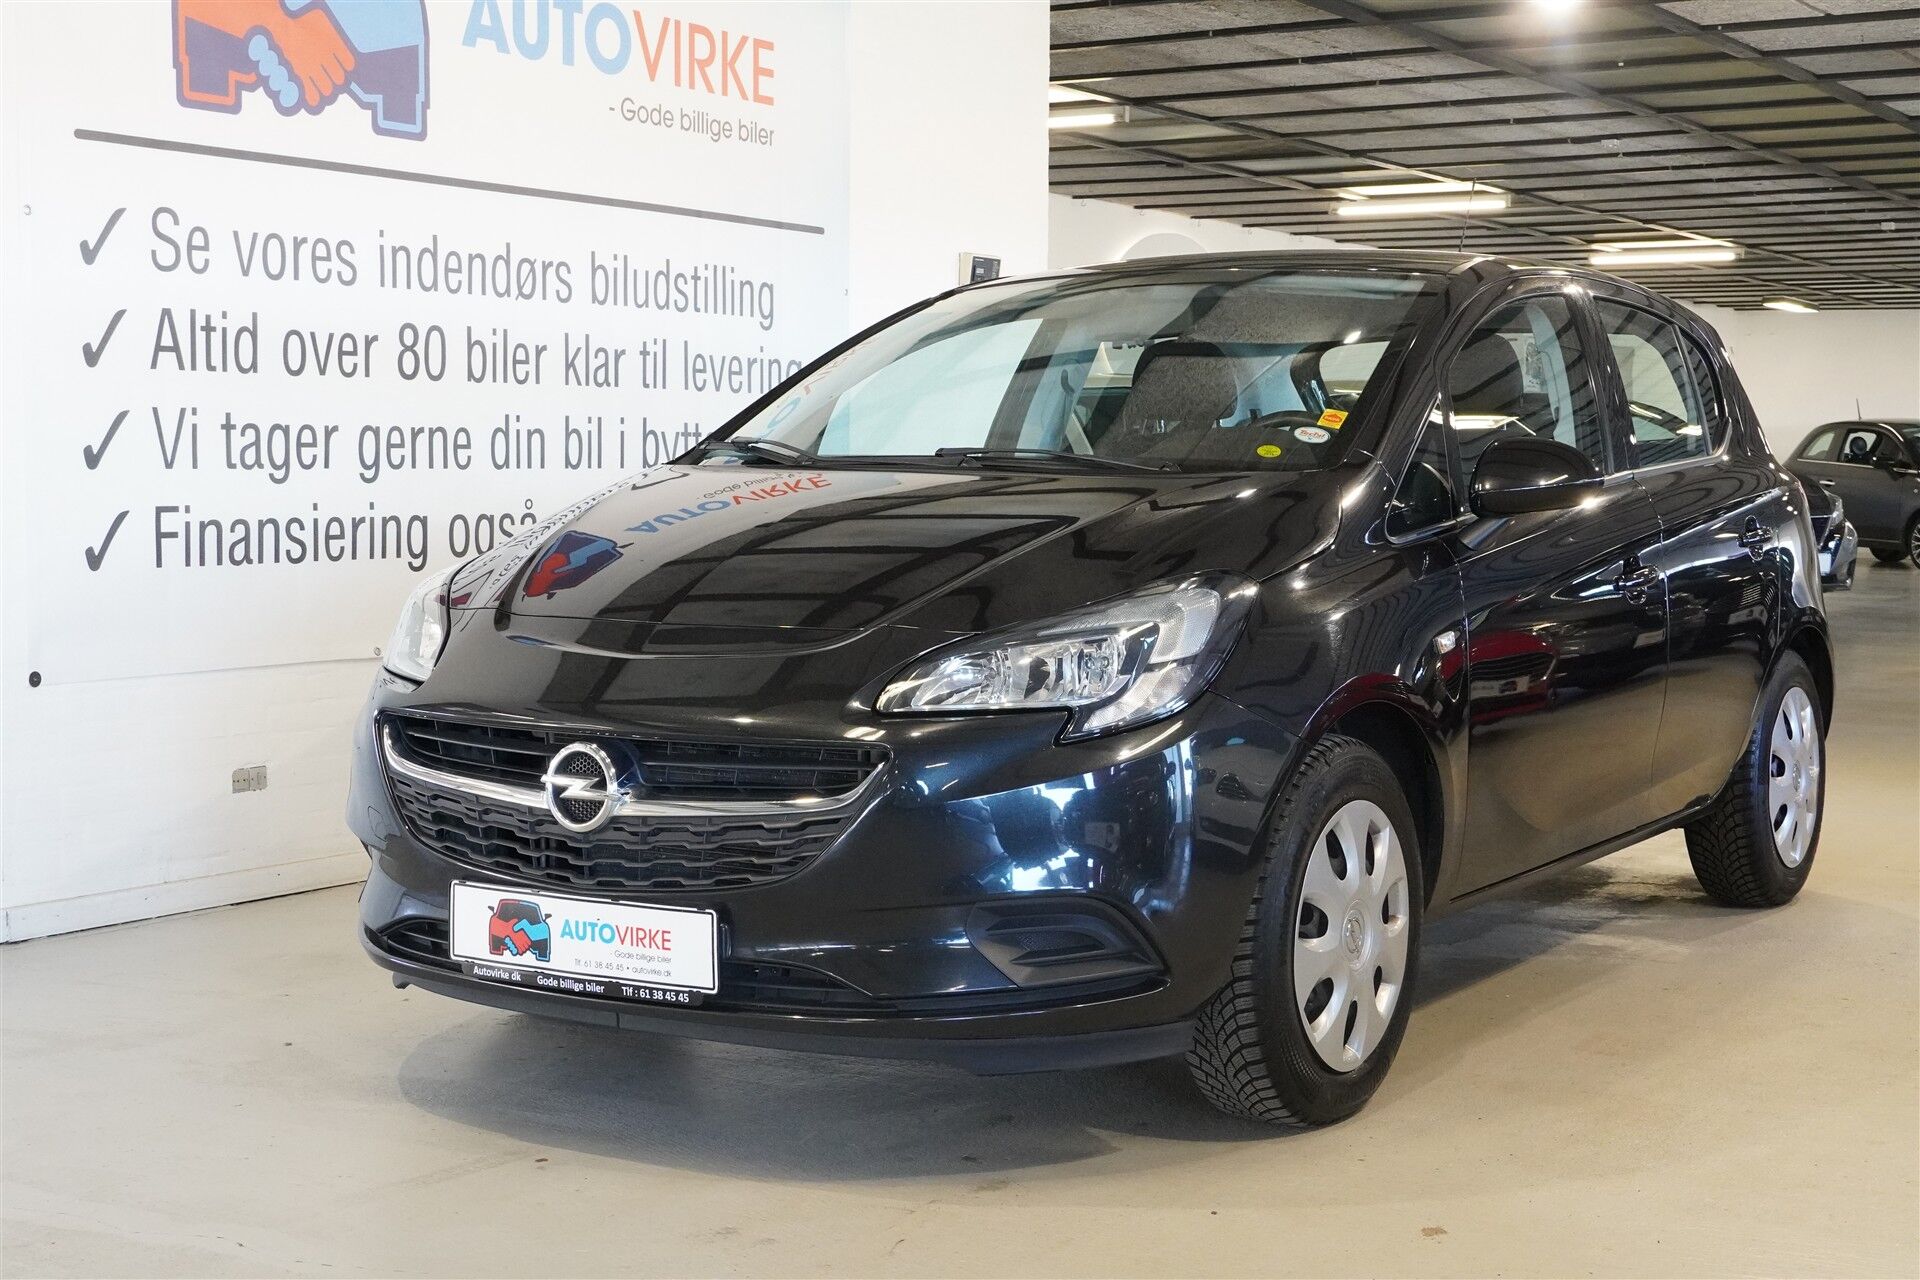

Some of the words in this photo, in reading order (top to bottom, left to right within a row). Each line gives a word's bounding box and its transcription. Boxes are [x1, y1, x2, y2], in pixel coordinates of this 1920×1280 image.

[462, 0, 775, 106] AUTOVIRKE
[620, 97, 674, 128] Gode
[680, 107, 733, 143] billige
[738, 118, 775, 146] biler
[150, 207, 210, 276] Se
[233, 230, 358, 287] vores
[379, 230, 573, 305] indendørs
[591, 250, 775, 332] biludstilling
[150, 307, 258, 376] Altid
[282, 329, 379, 379] over
[398, 323, 447, 382] 80
[466, 325, 548, 386] biler
[564, 332, 627, 390] klar
[639, 338, 667, 391] til
[151, 406, 199, 471] Vi
[221, 412, 339, 485] tager
[357, 424, 472, 485] gerne
[490, 413, 546, 471] din
[564, 415, 603, 471] bil
[619, 416, 625, 470] i
[642, 416, 711, 469] bytt
[154, 501, 429, 574] Finansiering
[560, 919, 671, 951] AUTOVIRKE
[614, 950, 635, 960] Gode
[636, 953, 656, 963] billige
[657, 955, 672, 963] biler
[473, 965, 510, 980] Autovirke
[511, 969, 522, 982] dk
[537, 975, 559, 988] Gode
[560, 977, 584, 992] billige
[585, 982, 605, 994] biler
[640, 988, 650, 999] 61
[652, 990, 664, 1000] 38
[665, 991, 676, 1002] 45
[678, 993, 689, 1003] 45
[583, 960, 592, 968] 61
[594, 961, 603, 969] 38
[604, 962, 614, 971] 45
[615, 963, 624, 972] 45
